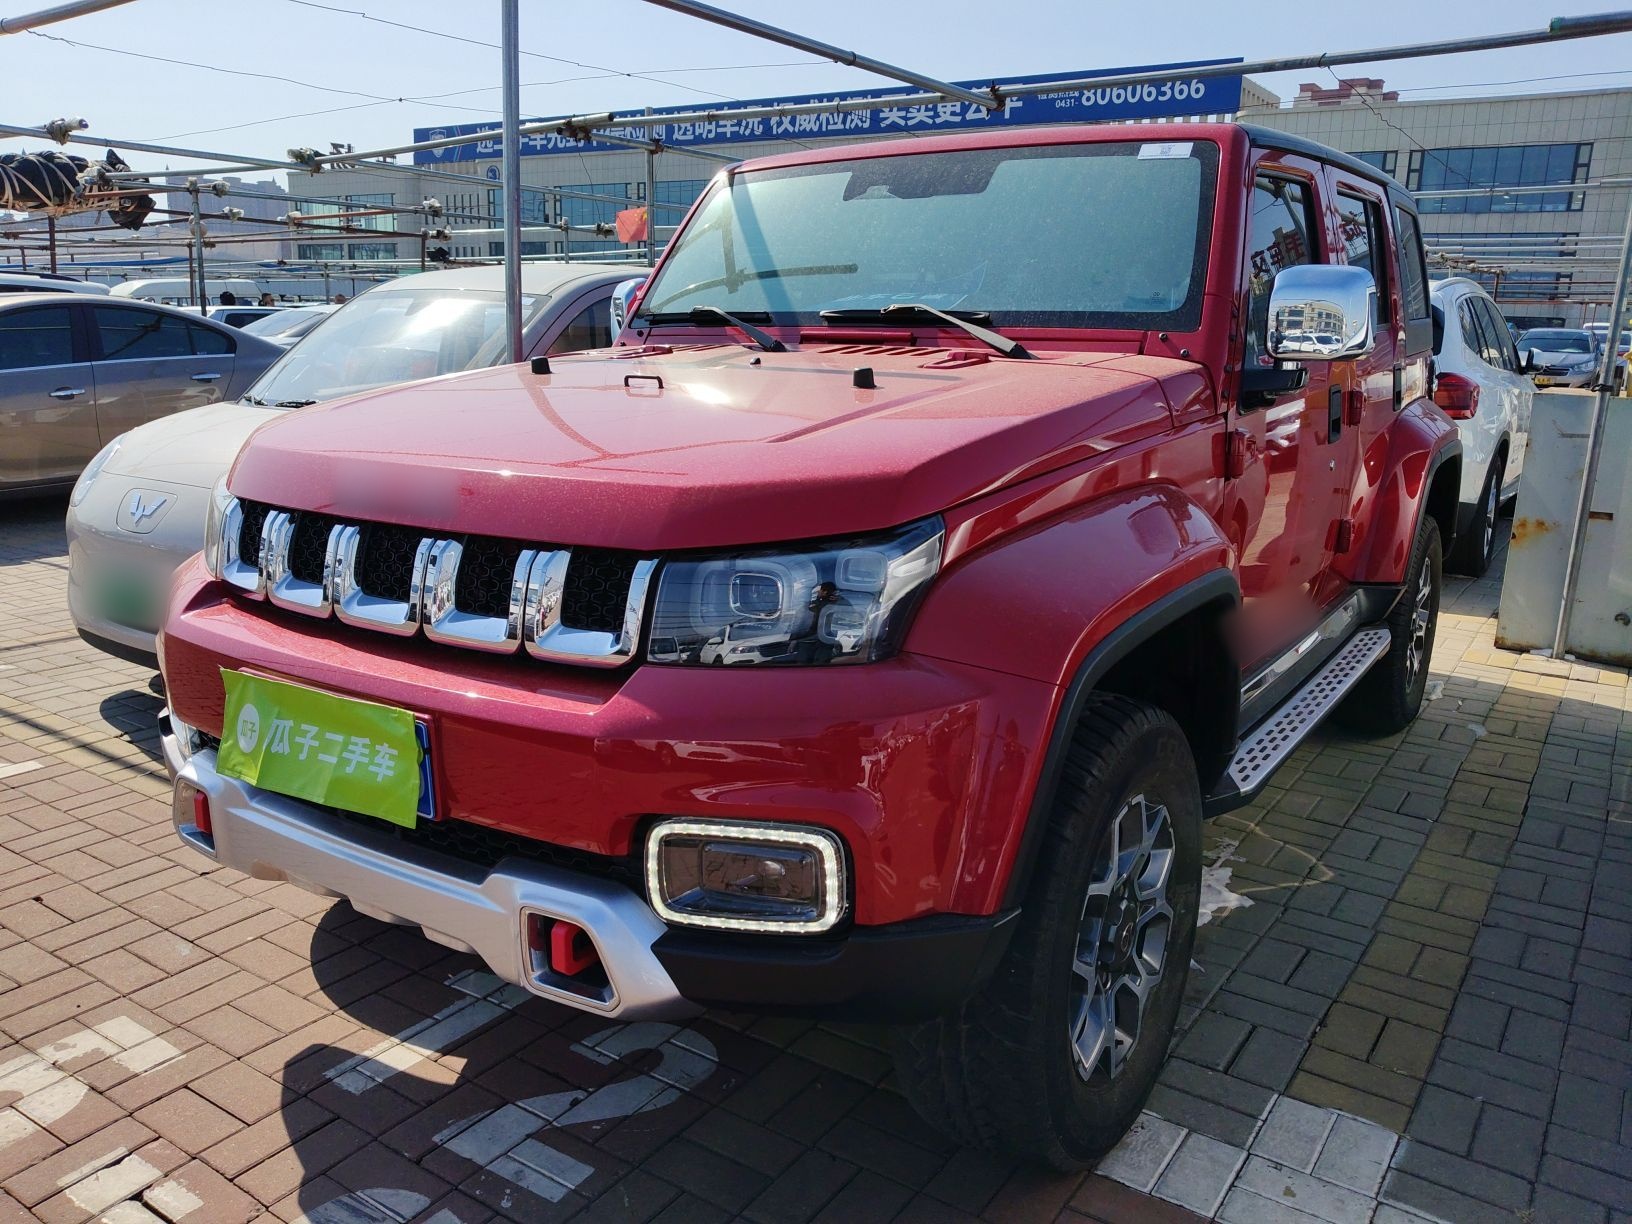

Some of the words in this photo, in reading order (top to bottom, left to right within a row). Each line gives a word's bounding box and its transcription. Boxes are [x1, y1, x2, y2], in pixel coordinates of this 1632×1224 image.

[1081, 79, 1207, 106] 80606366
[240, 719, 257, 740] 瓜子
[263, 718, 399, 783] 瓜子二手车
